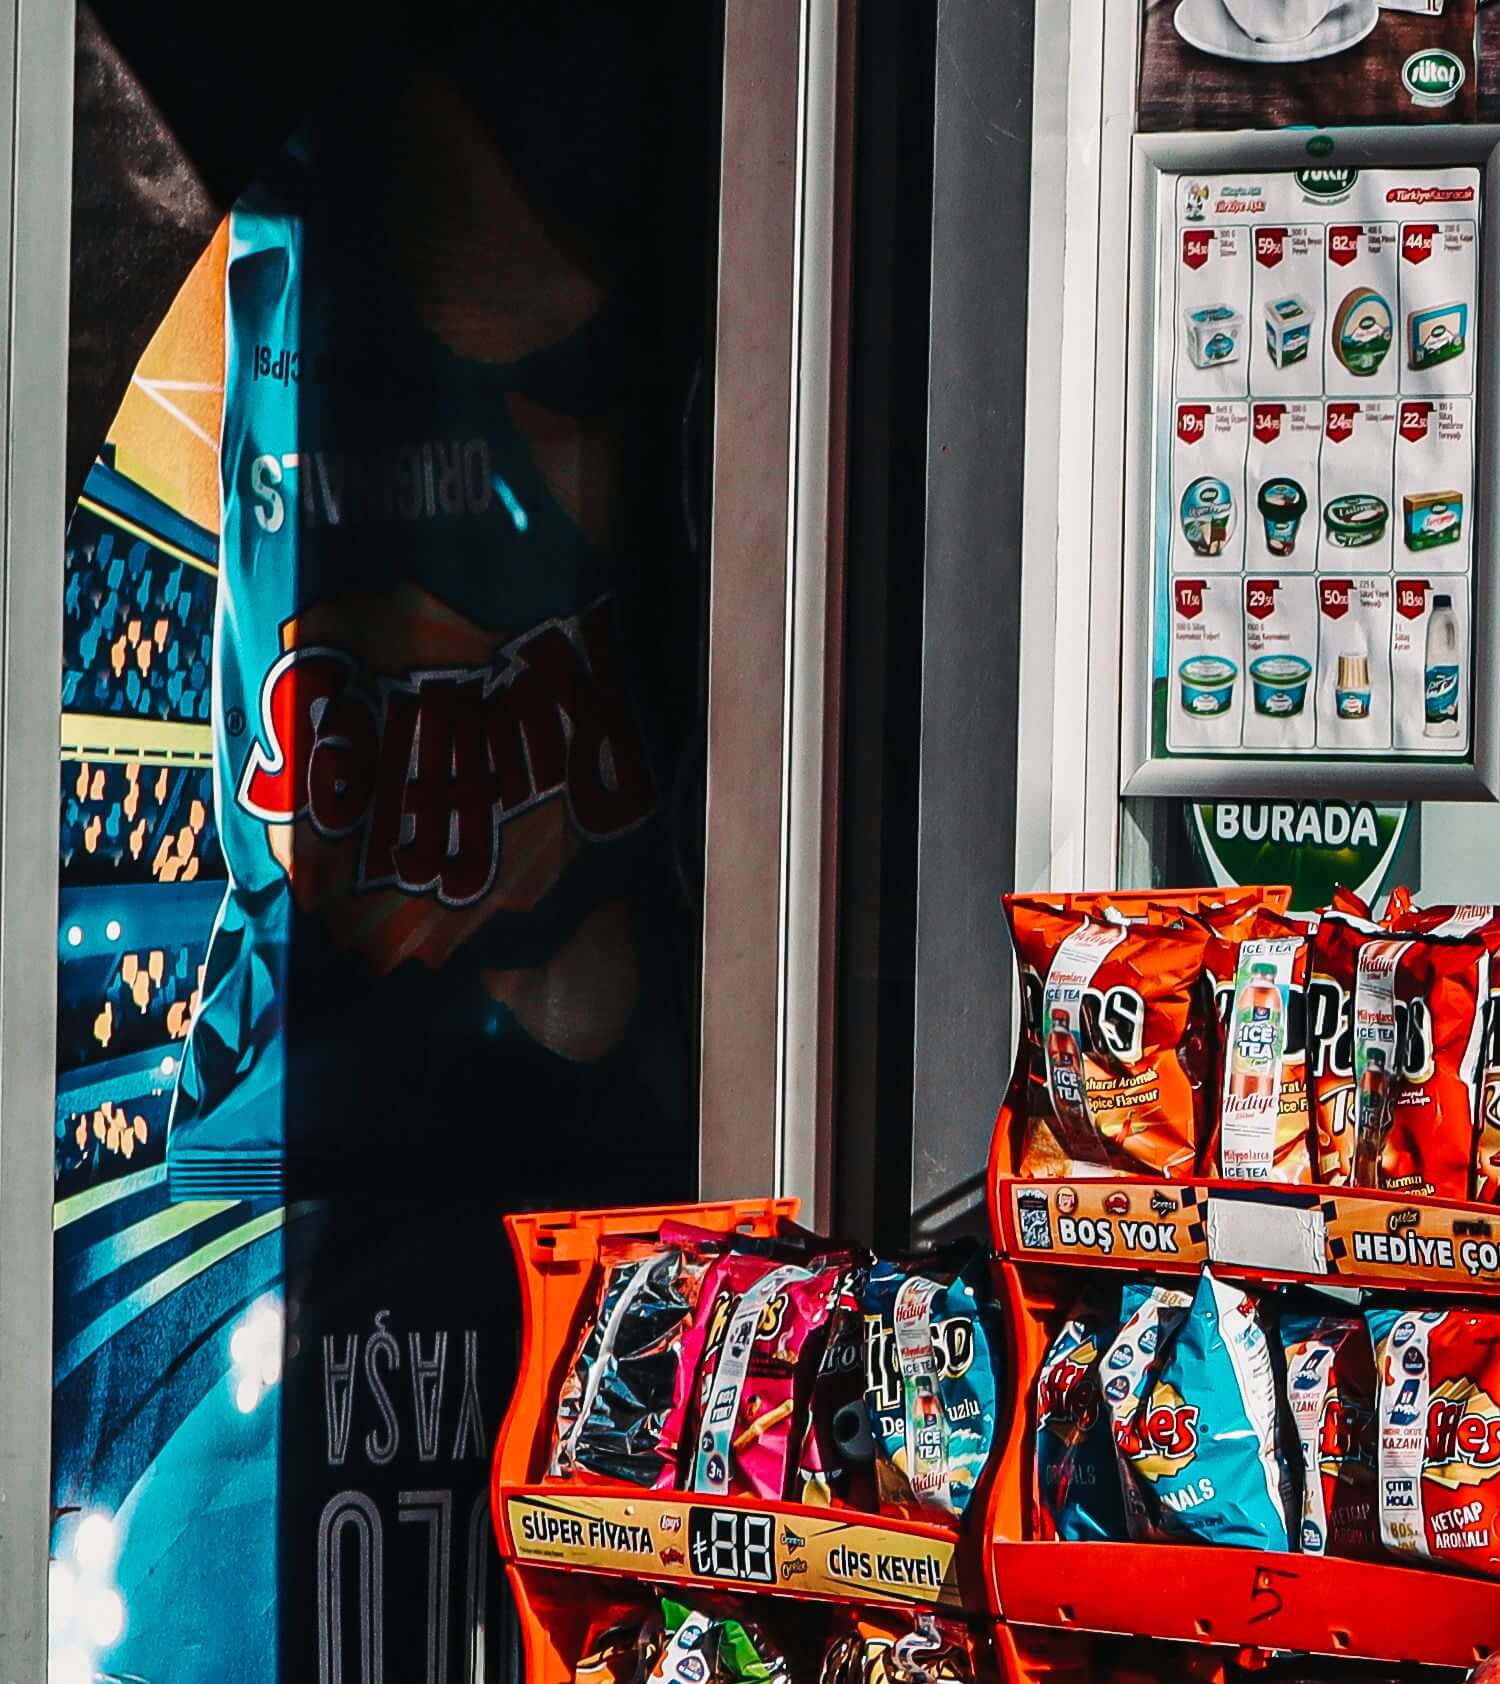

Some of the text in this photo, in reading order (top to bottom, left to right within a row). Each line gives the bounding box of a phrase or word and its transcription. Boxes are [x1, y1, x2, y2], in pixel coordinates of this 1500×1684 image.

[1215, 803, 1379, 847] BURADA
[1240, 1025, 1274, 1043] ICE
[1239, 1041, 1274, 1059] TEA
[1056, 1068, 1080, 1086] ICE
[1057, 1085, 1082, 1101] TEA
[1116, 1089, 1159, 1108] Flavour
[1224, 1167, 1268, 1178] ICE TEA
[1059, 1217, 1178, 1254] BOŞ YOK
[1353, 1231, 1456, 1268] HEDİYE
[322, 1308, 490, 1466] YAŞA
[947, 1399, 981, 1421] uzlu
[919, 1431, 942, 1446] ICE
[918, 1445, 942, 1459] TEA
[1430, 1501, 1484, 1533] KETÇAP
[521, 1510, 585, 1546] SÜPER
[588, 1518, 655, 1554] FİYATA
[828, 1543, 873, 1579] CİPS
[876, 1552, 943, 1587] KEYFİ!
[1435, 1529, 1489, 1549] AROMALI
